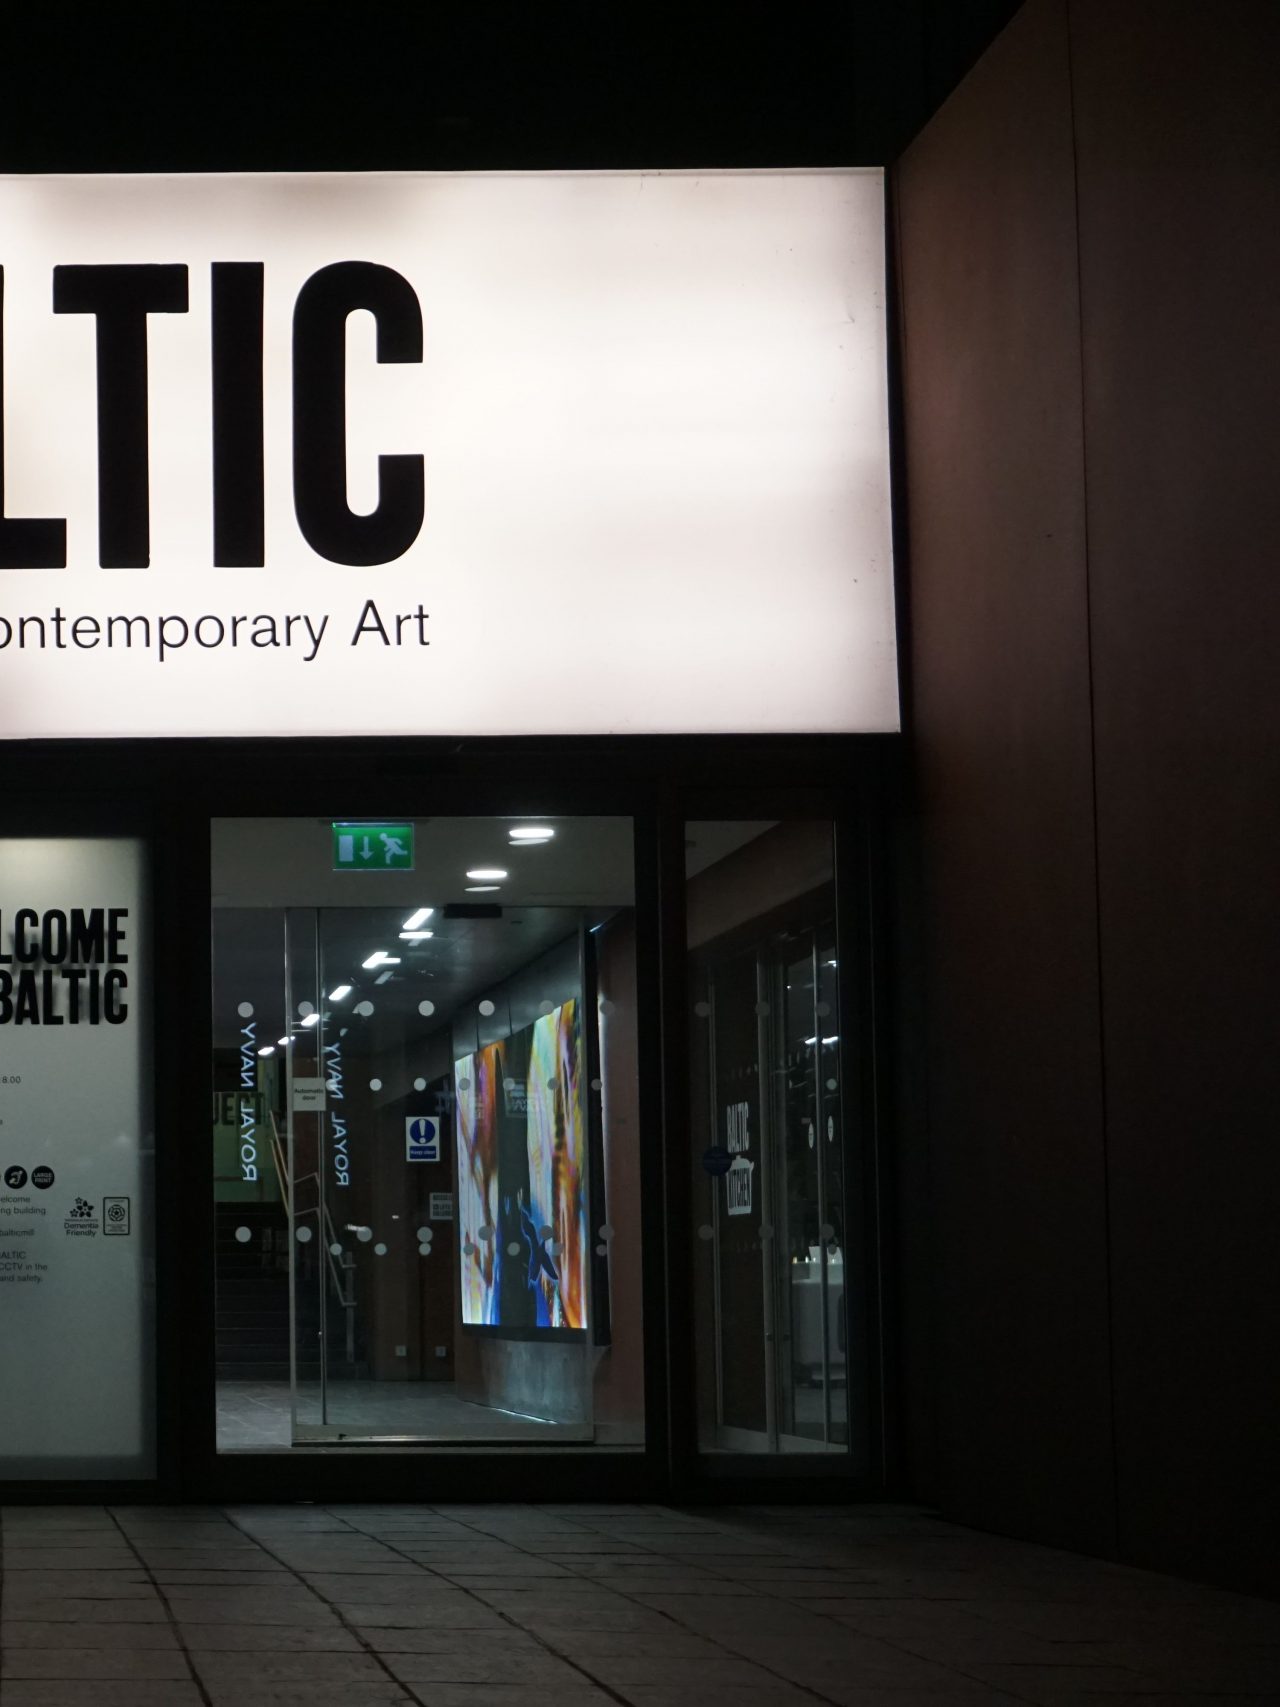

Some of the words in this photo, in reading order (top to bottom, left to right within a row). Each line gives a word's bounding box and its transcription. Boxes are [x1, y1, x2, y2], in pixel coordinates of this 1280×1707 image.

[350, 599, 430, 647] Art
[14, 1207, 46, 1216] building
[66, 1229, 96, 1237] Friendly
[35, 1263, 48, 1271] the
[0, 1274, 15, 1282] and
